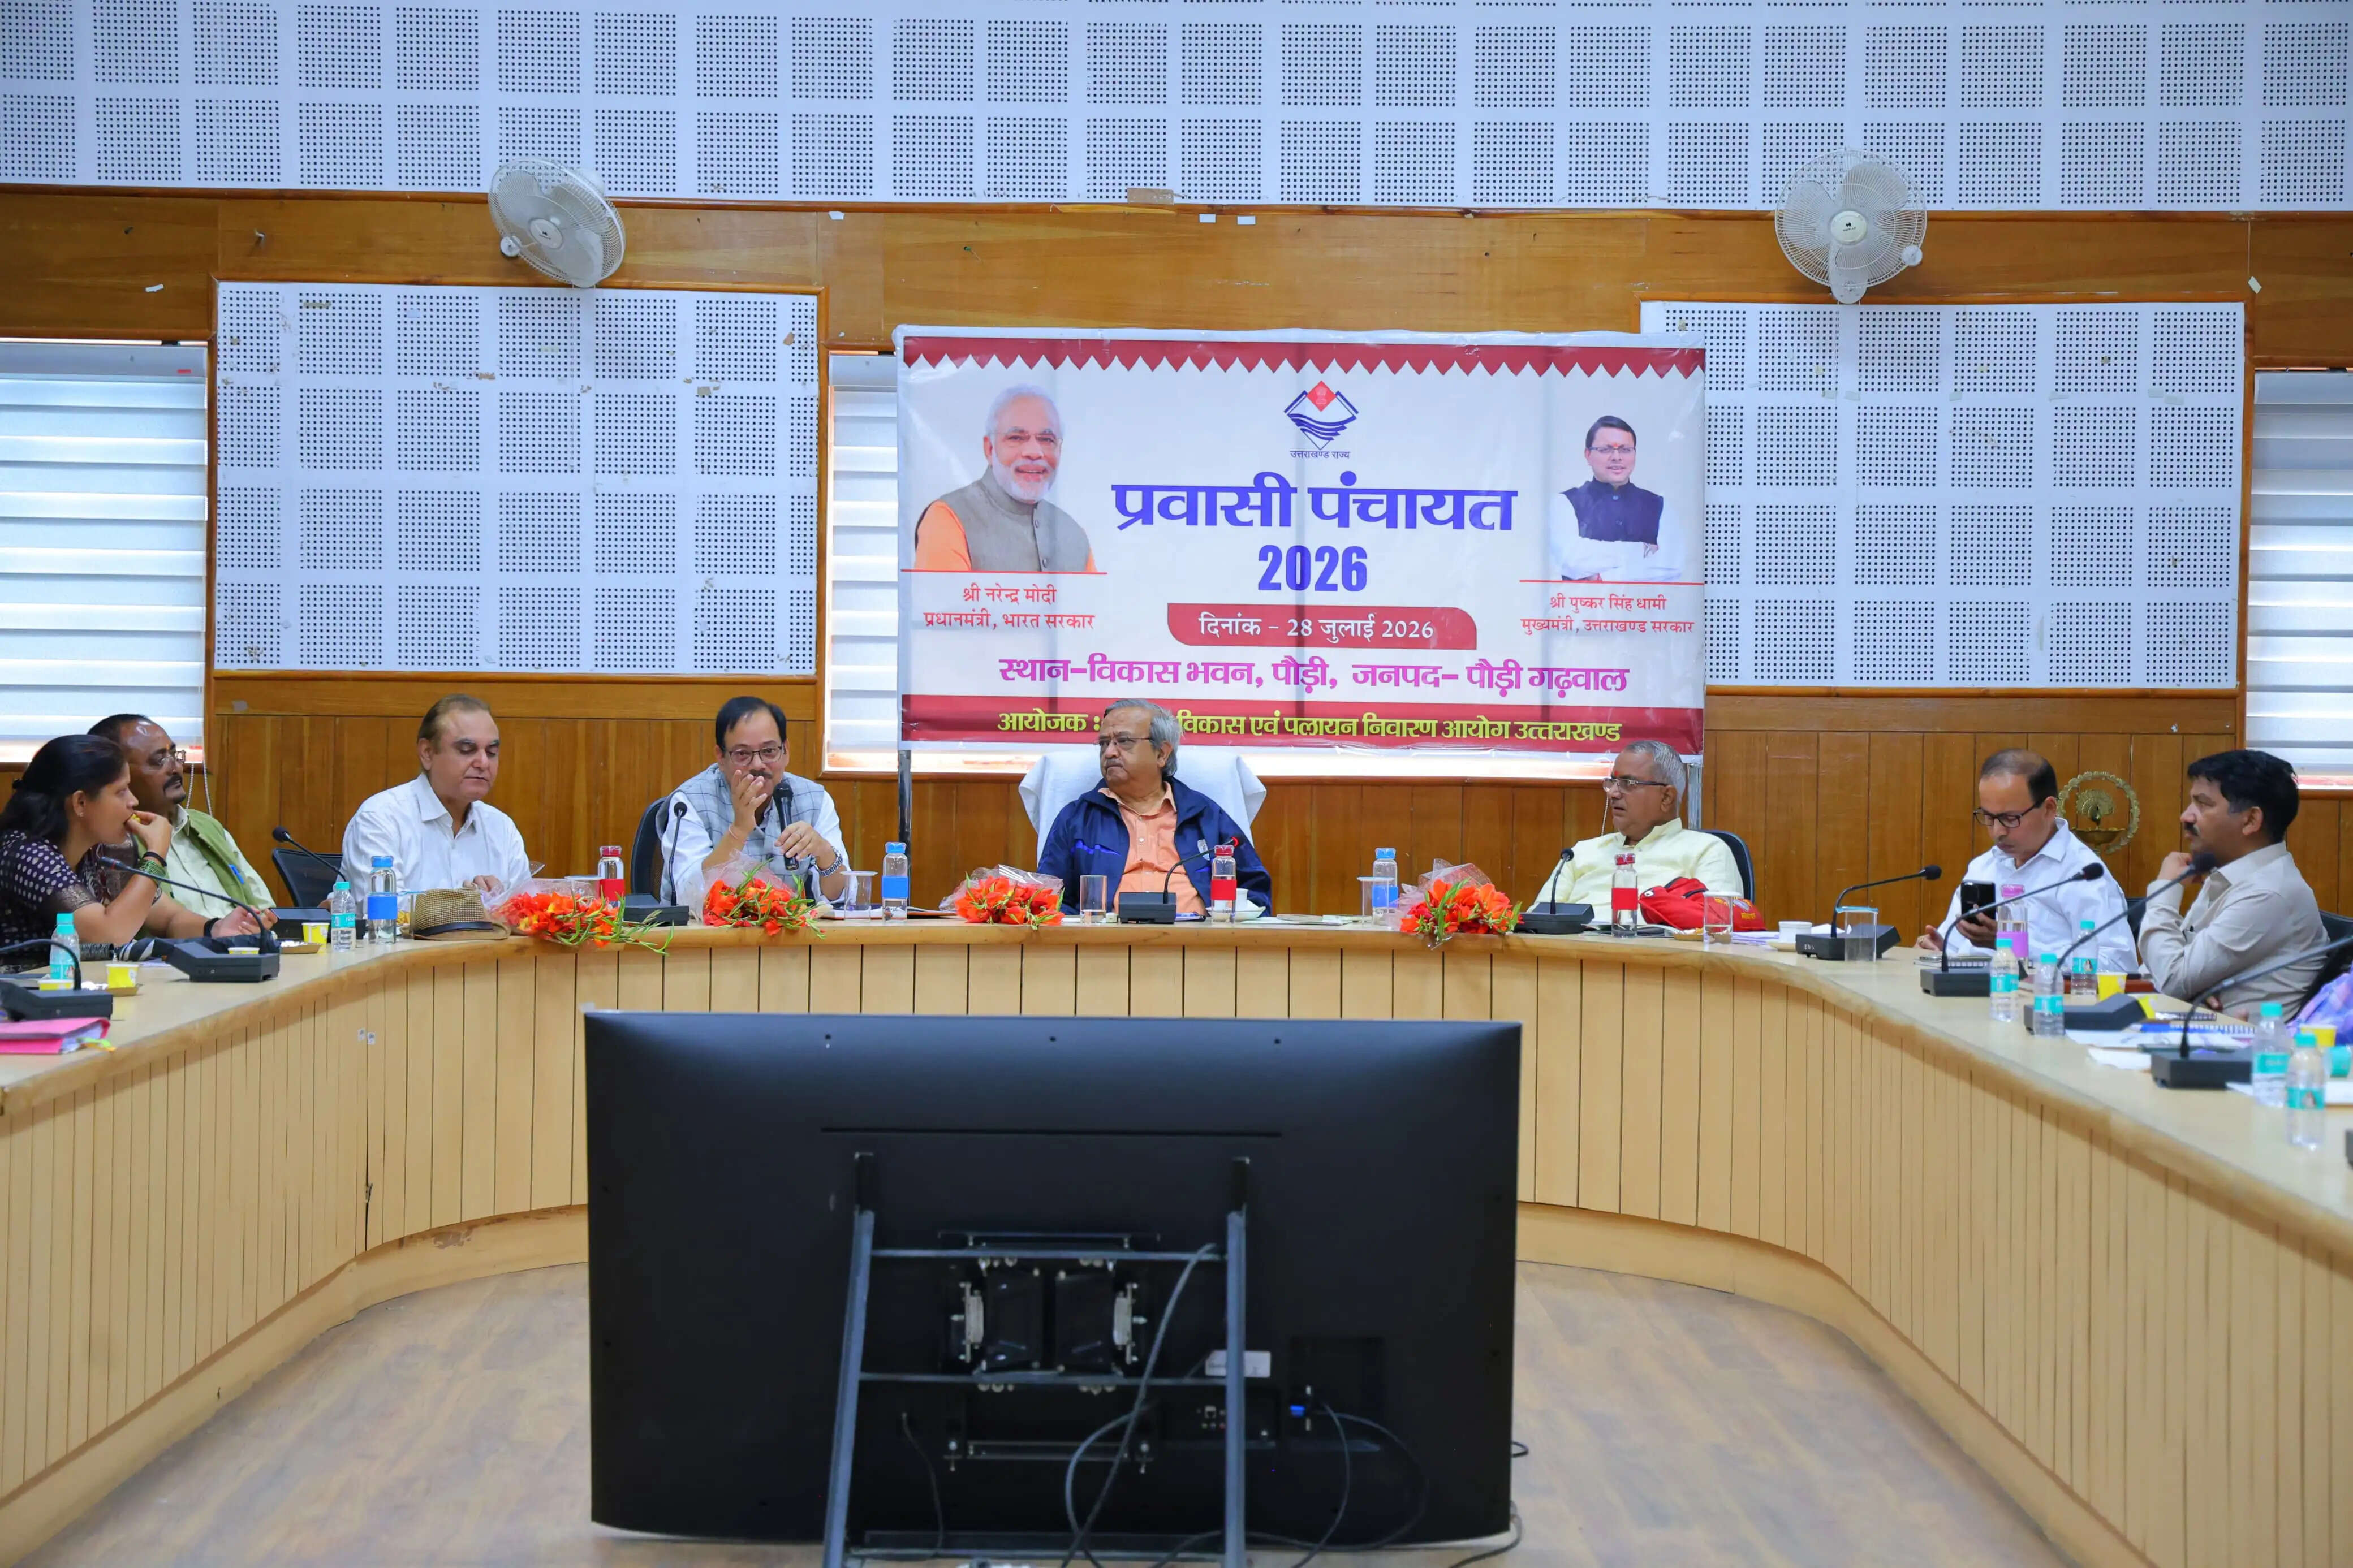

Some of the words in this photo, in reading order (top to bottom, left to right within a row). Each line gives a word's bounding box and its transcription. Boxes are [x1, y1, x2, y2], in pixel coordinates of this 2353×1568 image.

[1289, 450, 1330, 459] उत्तराखण्ड
[1111, 472, 1298, 530] प्रवासी
[1307, 471, 1518, 530] पंचायत
[1258, 545, 1368, 591] 2026
[963, 582, 981, 602] श्री
[985, 583, 1020, 604] नरेन्द्र
[1024, 584, 1057, 605] मोदी
[1550, 593, 1567, 609] श्री
[1569, 597, 1605, 614] पुष्कर
[1608, 594, 1634, 611] सिंह
[1637, 594, 1667, 610] धामी
[1002, 614, 1041, 628] भारत
[1044, 615, 1096, 628] सरकार
[1199, 611, 1262, 638] दिनांक
[1287, 619, 1313, 636] 28
[1317, 613, 1376, 643] जुलाई
[1382, 620, 1434, 638] 2026
[1582, 620, 1648, 633] उत्तराखण्ड
[1650, 621, 1695, 633] सरकार
[1186, 662, 1263, 688] भवन,
[1272, 655, 1338, 694] पौड़ी,
[1466, 658, 1523, 697] पौड़ी
[1528, 667, 1630, 698] गढ़वाल
[997, 707, 1088, 732] आयोजक
[1176, 709, 1247, 735] विकास
[1249, 710, 1281, 736] एवं
[1283, 717, 1359, 736] पलायन
[1362, 712, 1438, 738] निवारण
[1441, 715, 1511, 739] आयोग
[1513, 721, 1623, 742] उत्तराखण्ड
